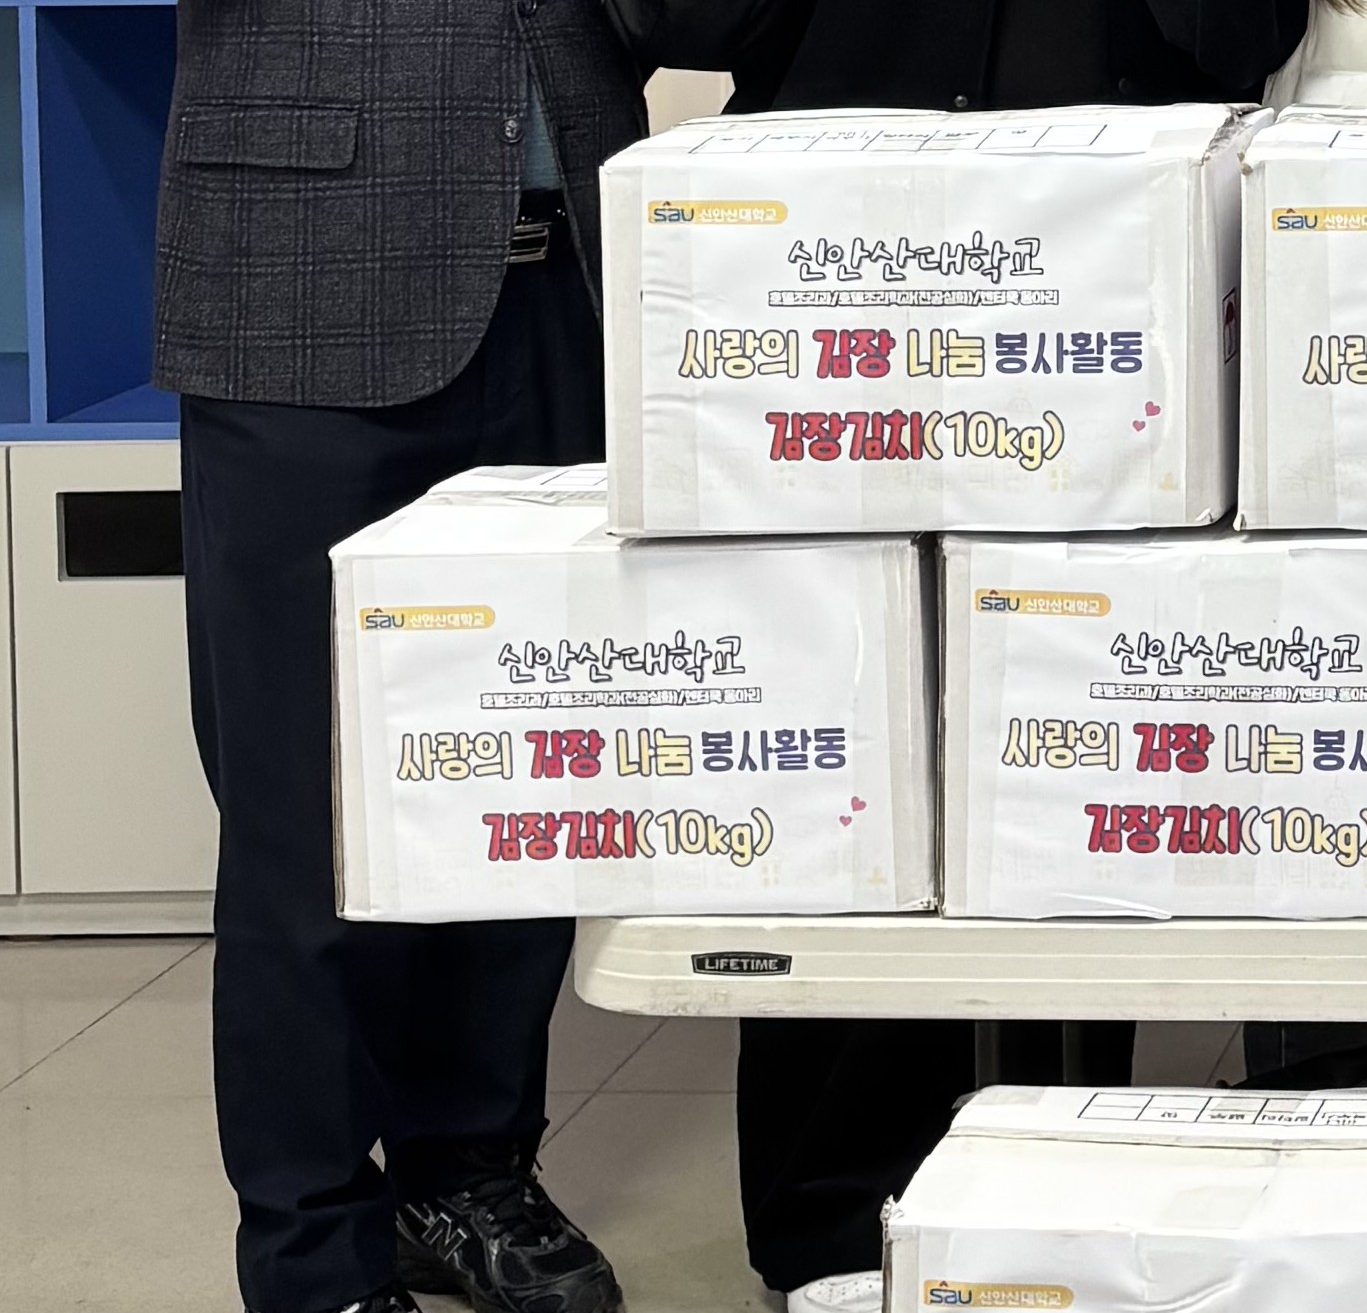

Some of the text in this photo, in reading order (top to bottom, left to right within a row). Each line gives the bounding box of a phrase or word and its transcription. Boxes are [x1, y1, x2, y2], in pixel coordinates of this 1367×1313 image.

[788, 231, 1044, 283] 신안산대학교
[678, 329, 1143, 379] 사랑의 김장 나눔 봉사활동
[766, 410, 1065, 471] 김장김치(10kg)
[1110, 624, 1363, 680] 신안산대학교
[482, 806, 775, 871] 김장김치(10kg)
[704, 957, 779, 972] LIFETIME
